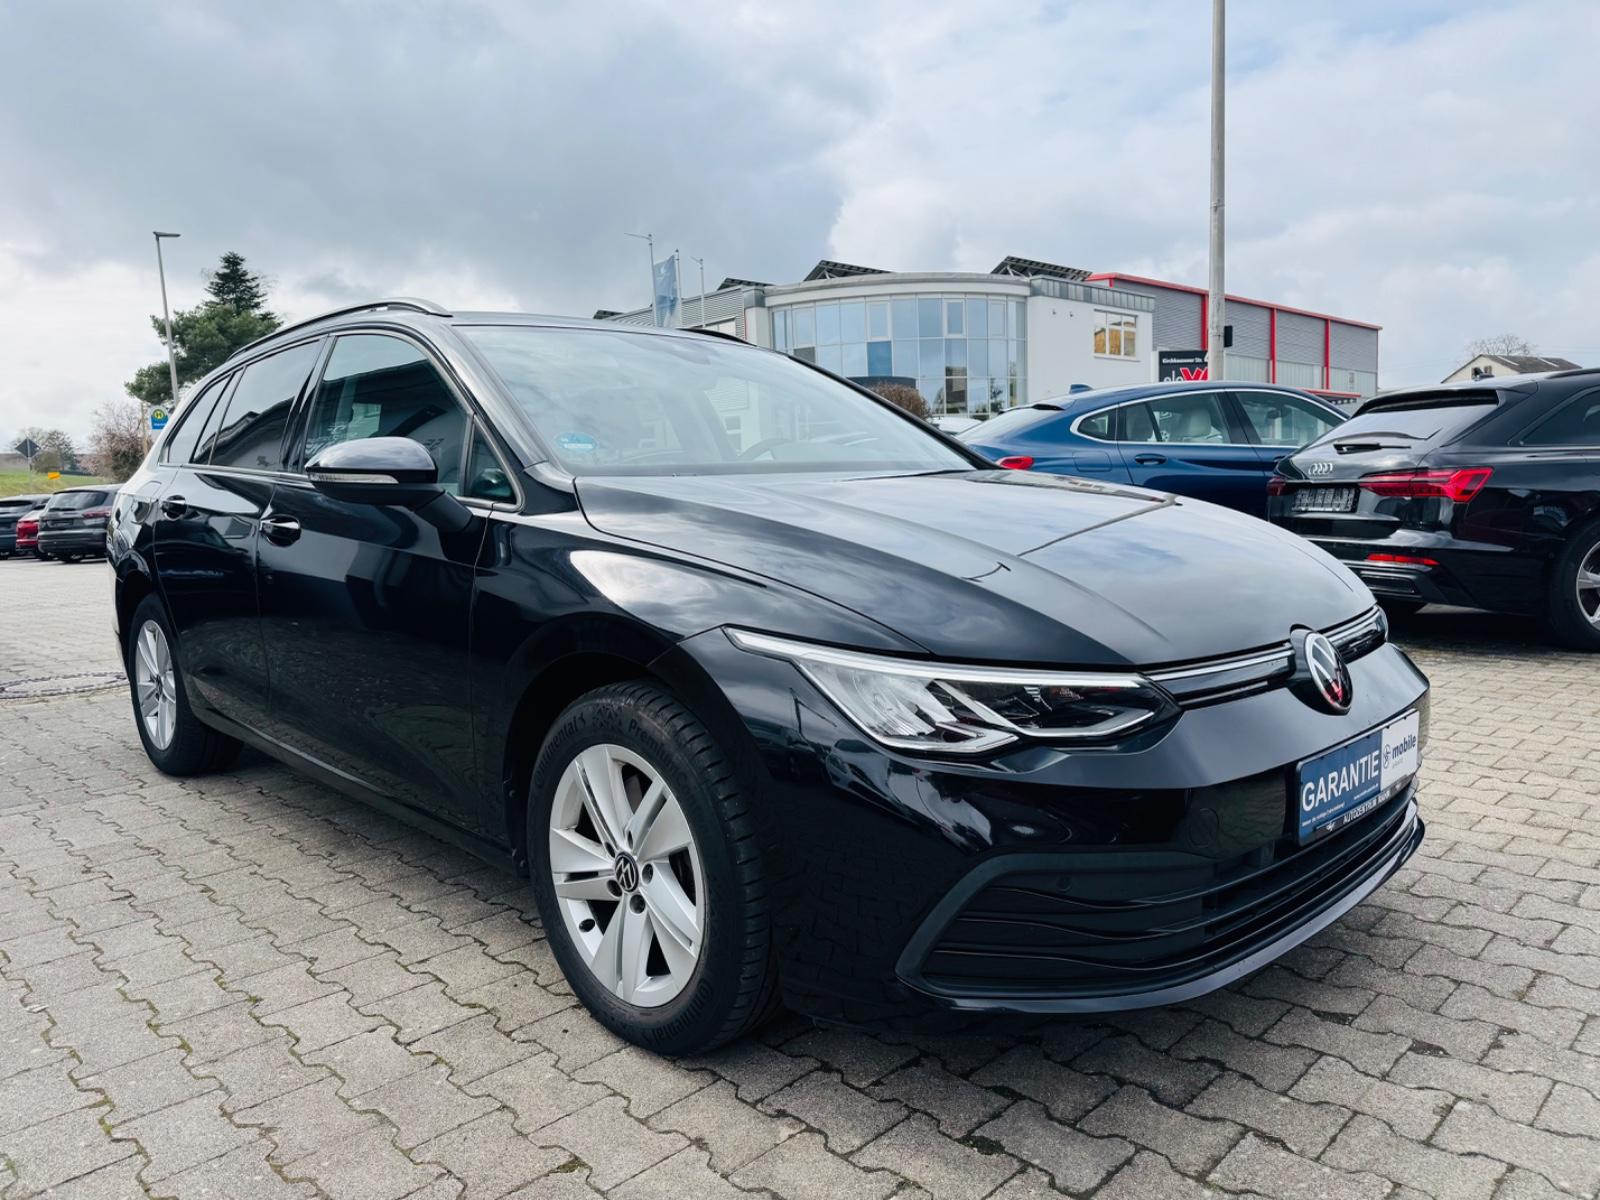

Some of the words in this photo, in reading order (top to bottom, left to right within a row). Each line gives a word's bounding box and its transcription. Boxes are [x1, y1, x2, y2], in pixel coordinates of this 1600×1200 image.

[533, 716, 580, 788] Continental
[1392, 734, 1416, 759] mobile
[1302, 750, 1379, 811] GARANTIE
